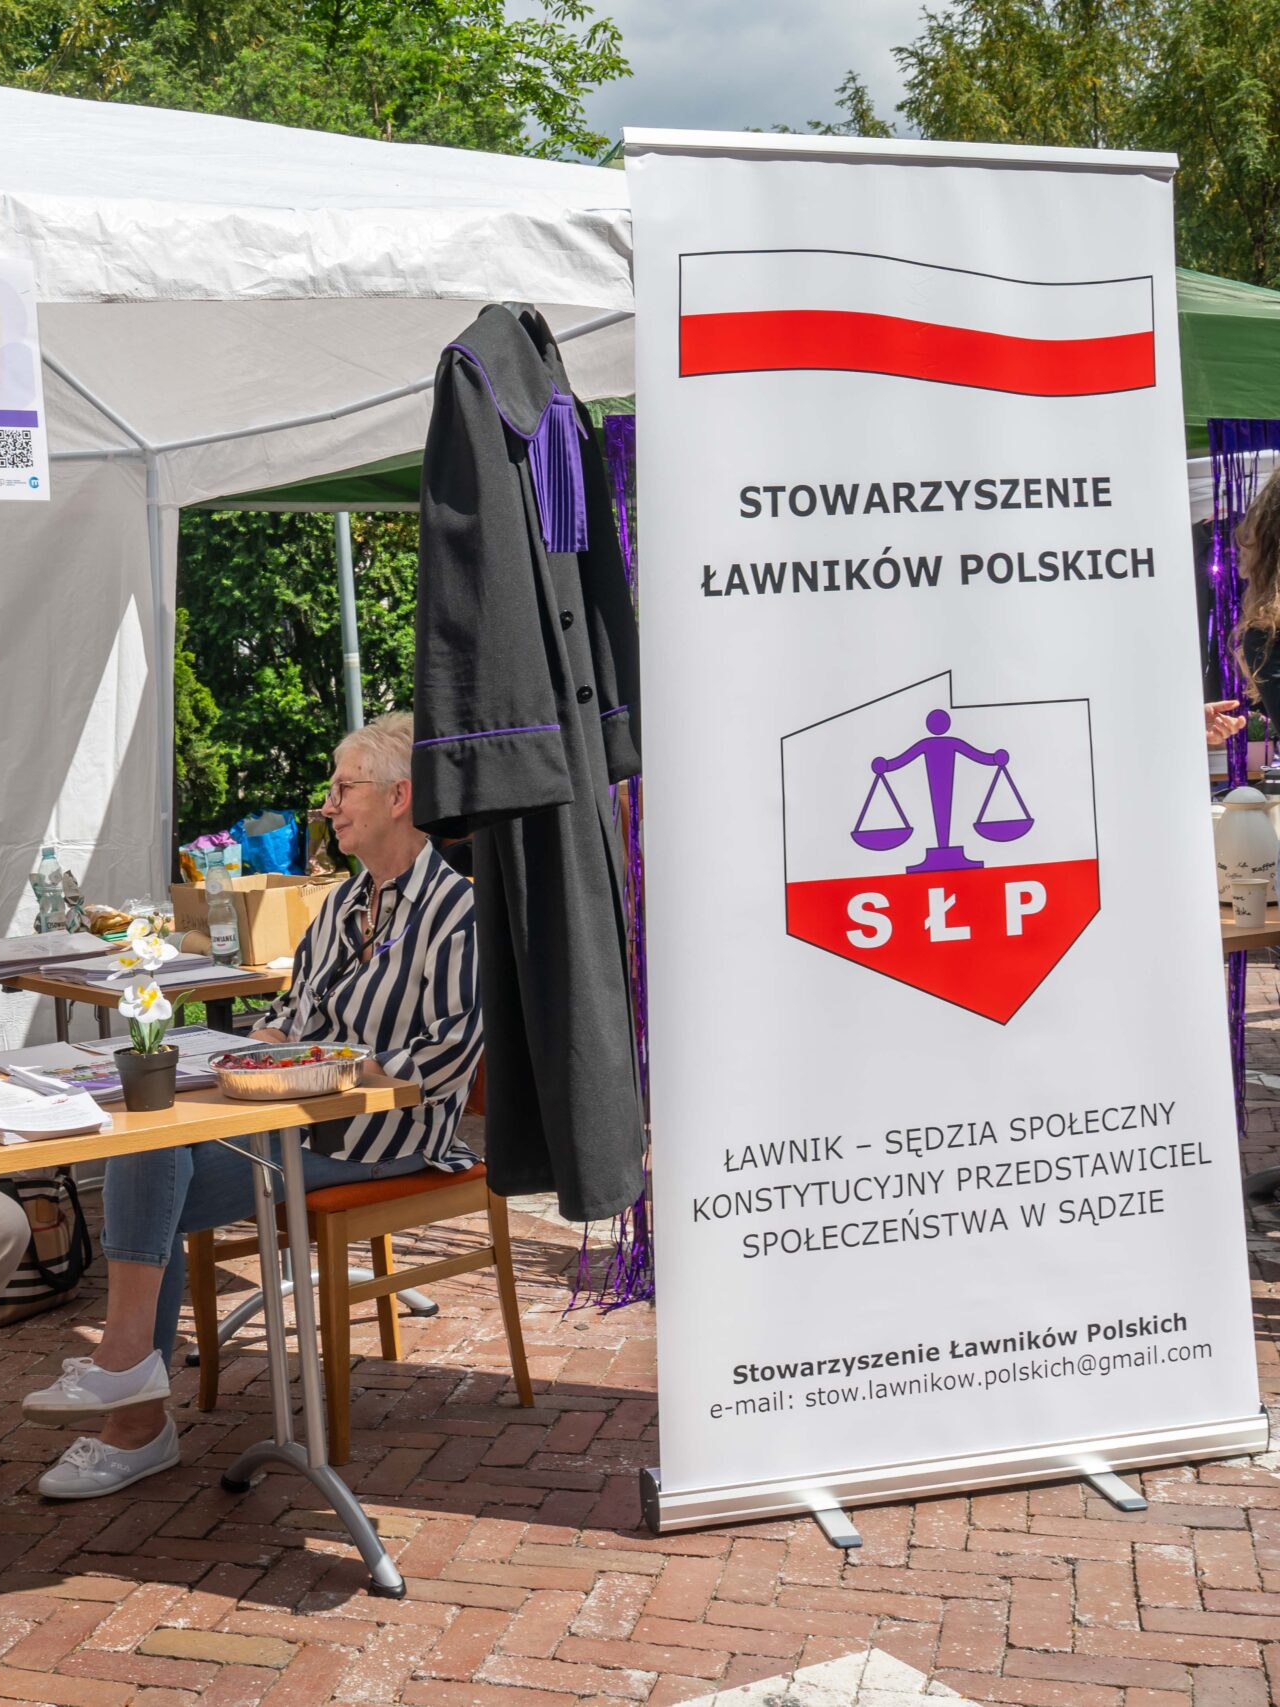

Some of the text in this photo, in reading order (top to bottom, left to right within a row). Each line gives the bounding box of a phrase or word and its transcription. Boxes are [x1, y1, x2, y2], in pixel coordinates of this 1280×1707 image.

[739, 477, 1113, 519] STOWARZYSZENIE
[701, 546, 1156, 597] ŁAWNIKÓW POLSKICH
[723, 1135, 844, 1173] ŁAWNIK
[884, 1121, 998, 1158] SĘDZIA
[1009, 1101, 1177, 1143] SPOŁECZNY
[692, 1141, 1212, 1223] KONSTYTUCYJNY PRZEDSTAWICIEL
[742, 1190, 1165, 1259] SPOŁECZEŃSTWA W SĄDZIE
[710, 1339, 1214, 1420] e-mail: stow.lawnikow.polskich@gmail.com
[733, 1312, 1188, 1386] Stowarzyszenie Ławników Polskich
